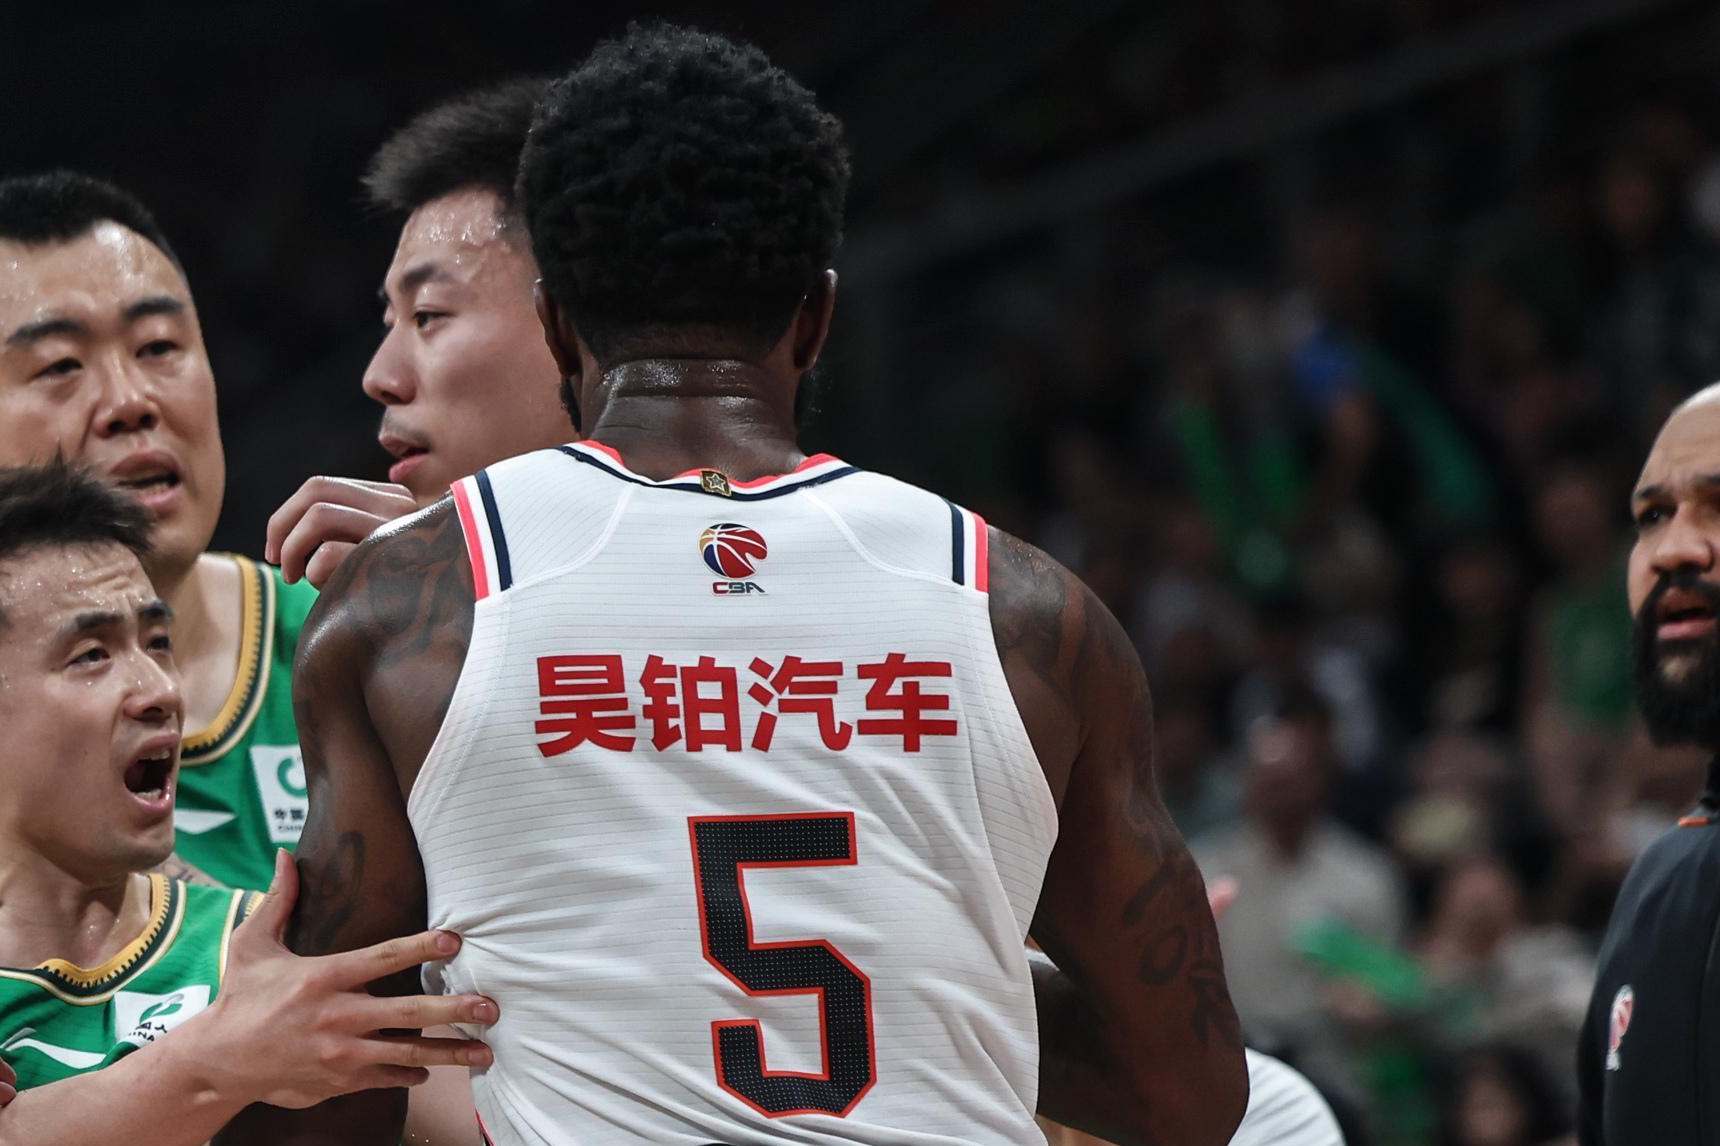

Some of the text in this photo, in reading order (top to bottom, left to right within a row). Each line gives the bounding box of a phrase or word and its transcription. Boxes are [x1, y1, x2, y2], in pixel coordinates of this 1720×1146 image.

[712, 581, 766, 595] CBA
[534, 652, 959, 758] 昊铂汽车
[687, 811, 878, 1119] 5
